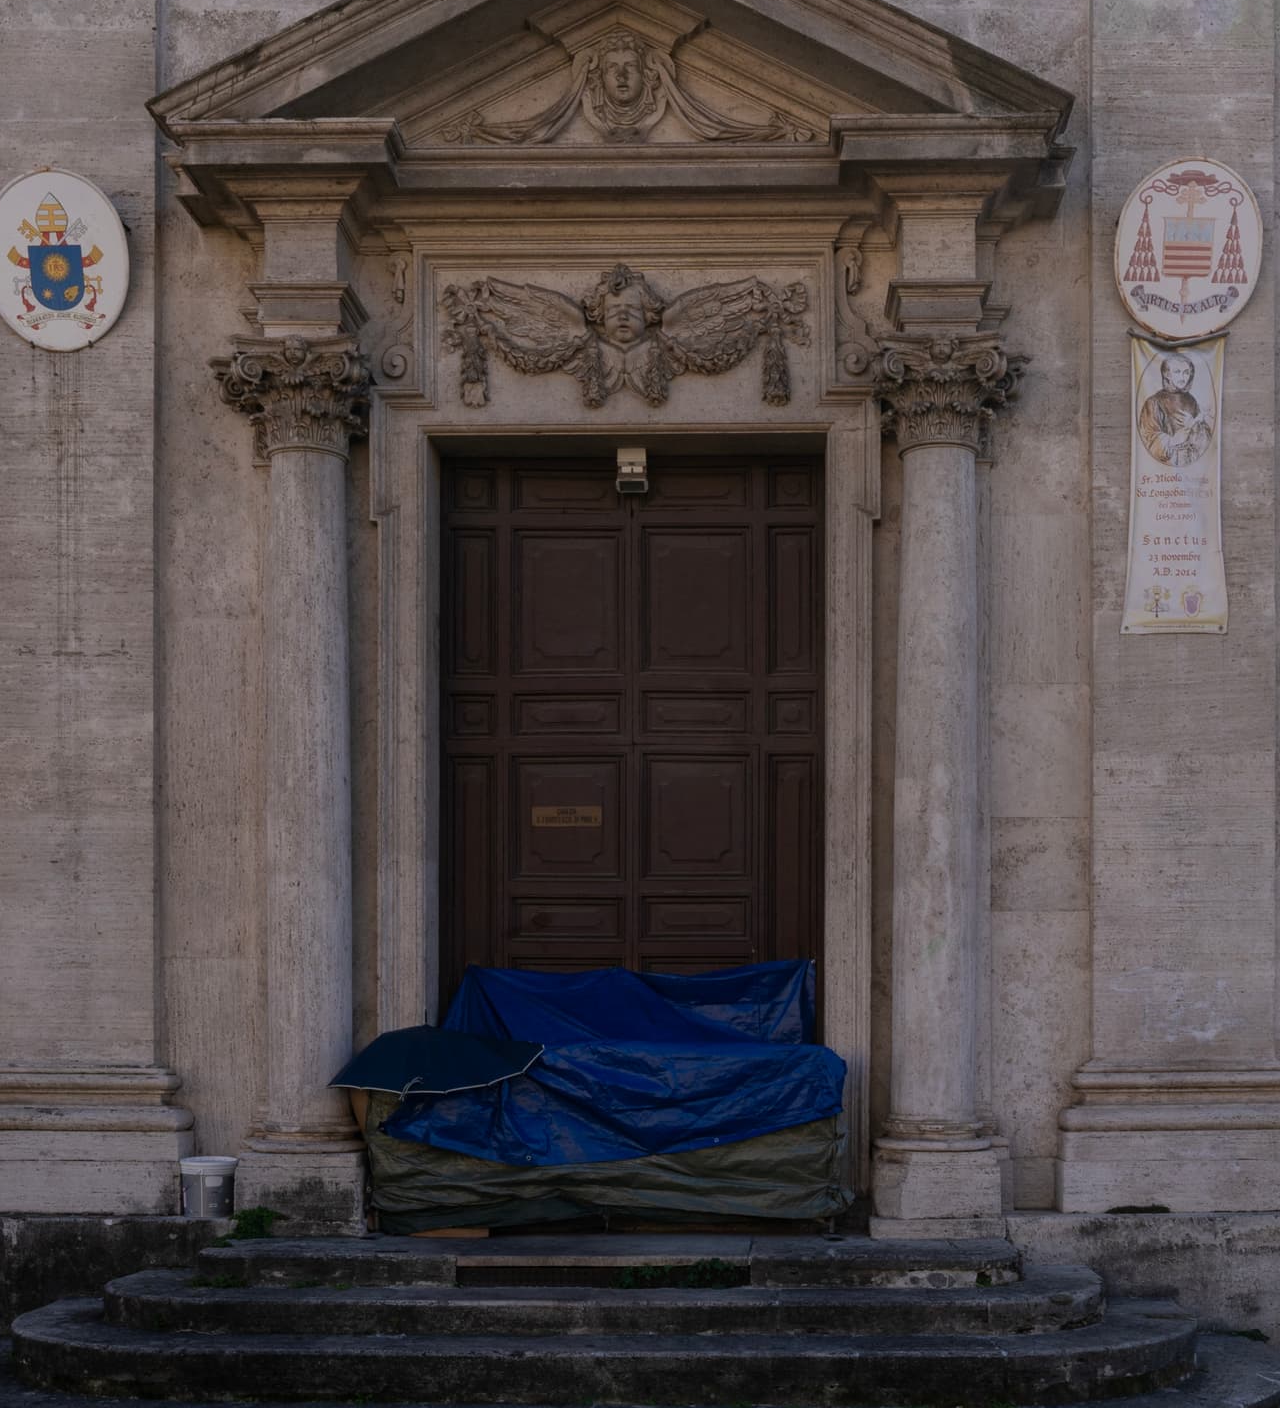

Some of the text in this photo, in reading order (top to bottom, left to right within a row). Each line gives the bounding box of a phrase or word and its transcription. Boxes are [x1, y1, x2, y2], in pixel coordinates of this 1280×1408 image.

[1138, 293, 1229, 314] VIRTUS EX ALTO
[1142, 534, 1208, 546] Sanctus
[1161, 551, 1201, 562] novembre
[1175, 569, 1197, 577] 2014
